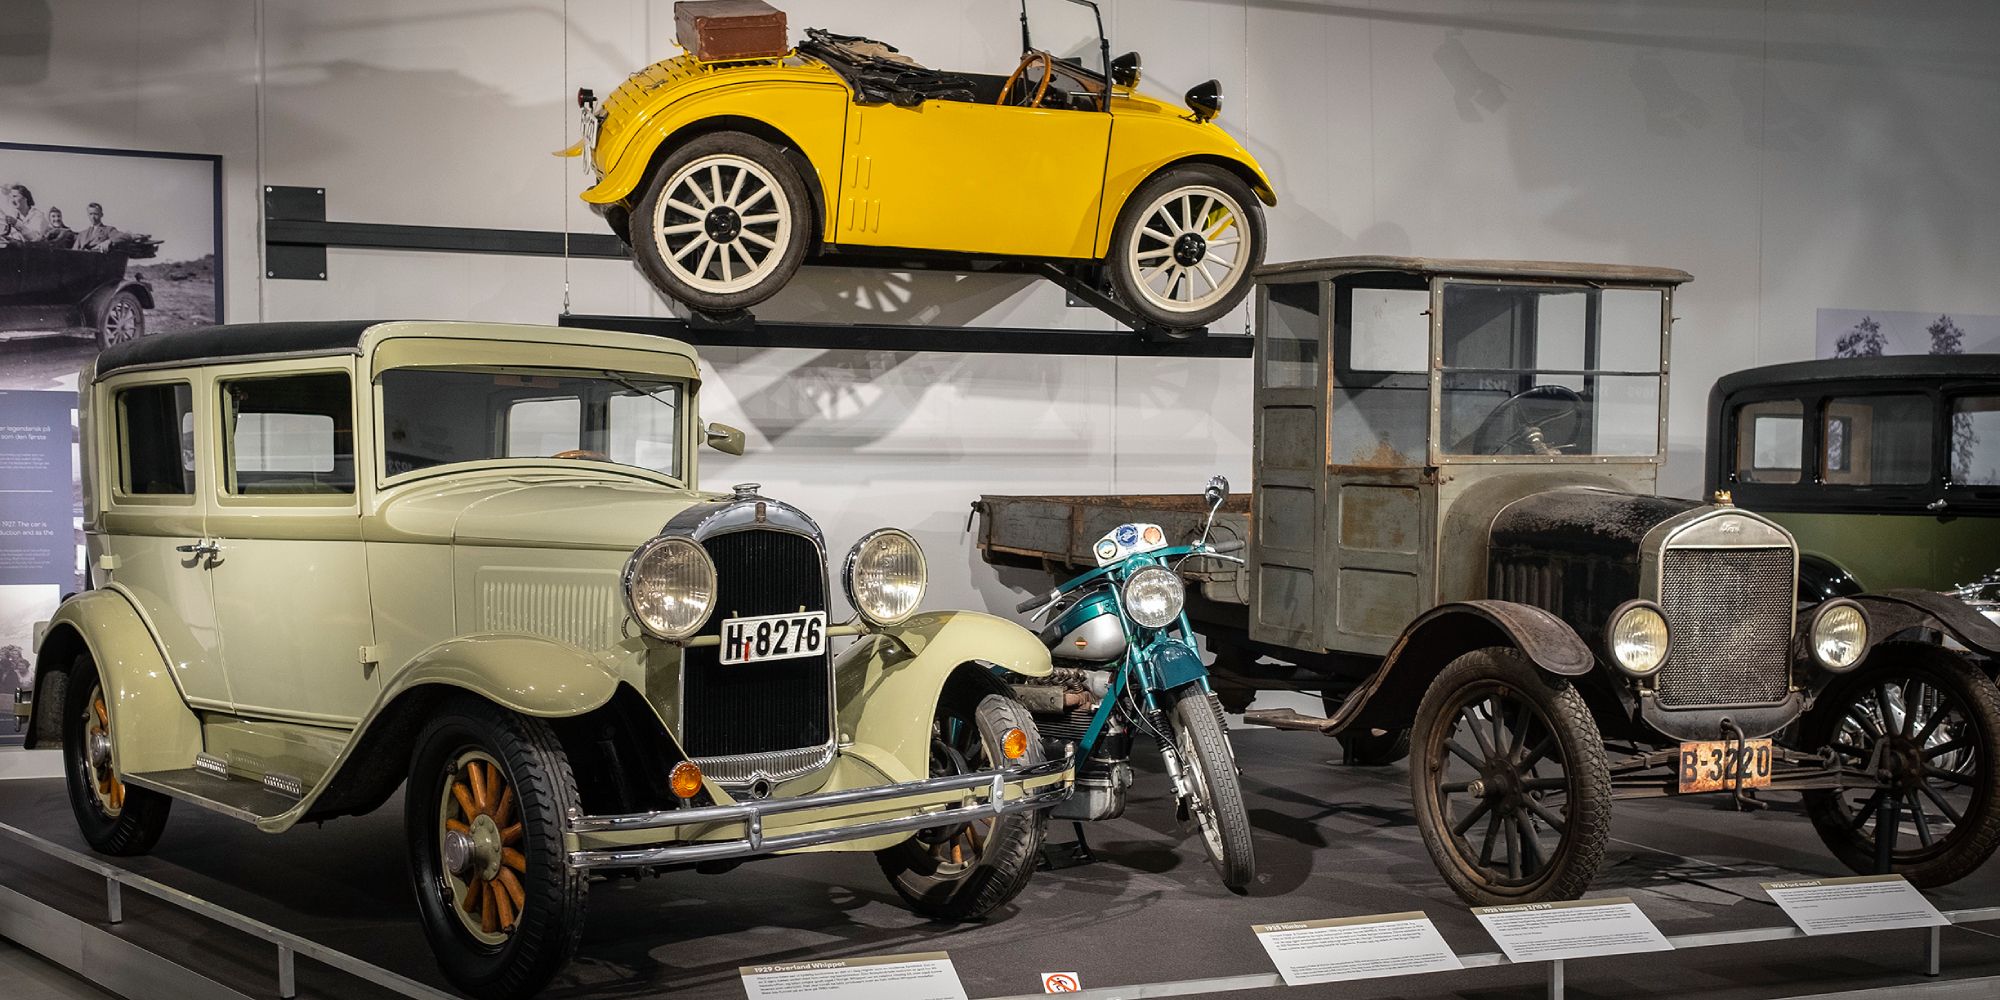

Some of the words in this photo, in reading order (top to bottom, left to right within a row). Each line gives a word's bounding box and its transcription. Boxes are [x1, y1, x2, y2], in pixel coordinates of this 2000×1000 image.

[42, 425, 51, 433] på
[18, 520, 30, 528] The
[725, 617, 822, 661] H-8276
[1681, 745, 1769, 783] B-3220
[774, 963, 811, 972] Overland
[811, 961, 846, 970] Whippet
